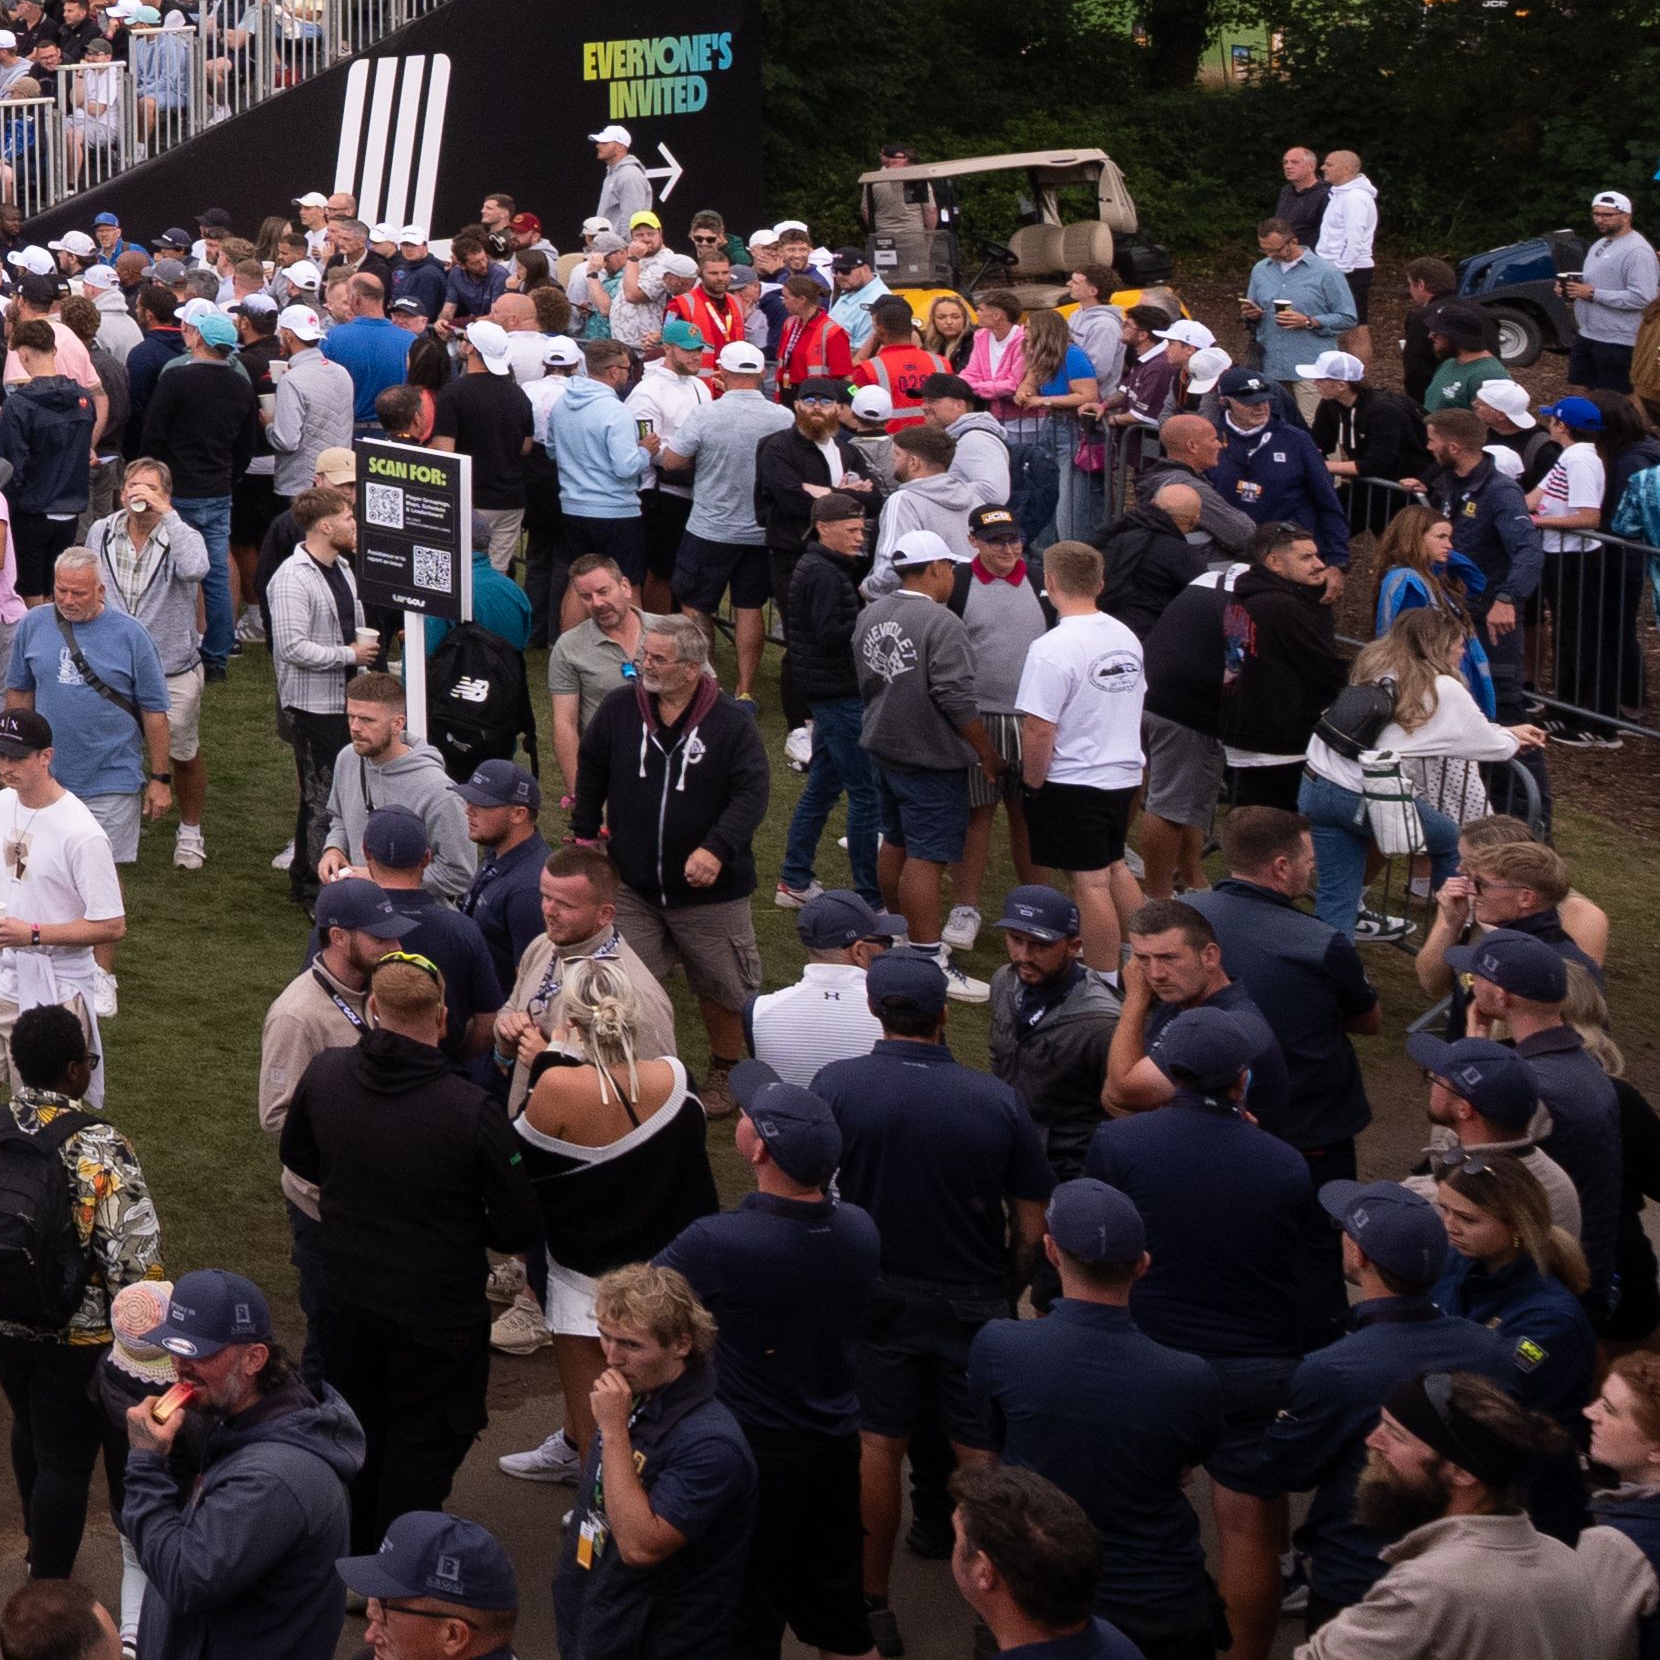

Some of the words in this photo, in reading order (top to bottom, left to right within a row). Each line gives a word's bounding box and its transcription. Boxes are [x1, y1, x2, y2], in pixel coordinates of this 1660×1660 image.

[583, 32, 733, 81] EVERYONE'S
[609, 75, 708, 120] INVITED
[368, 456, 409, 480] SCAN
[409, 463, 448, 487] FOR:
[863, 621, 918, 659] CHEVROLET
